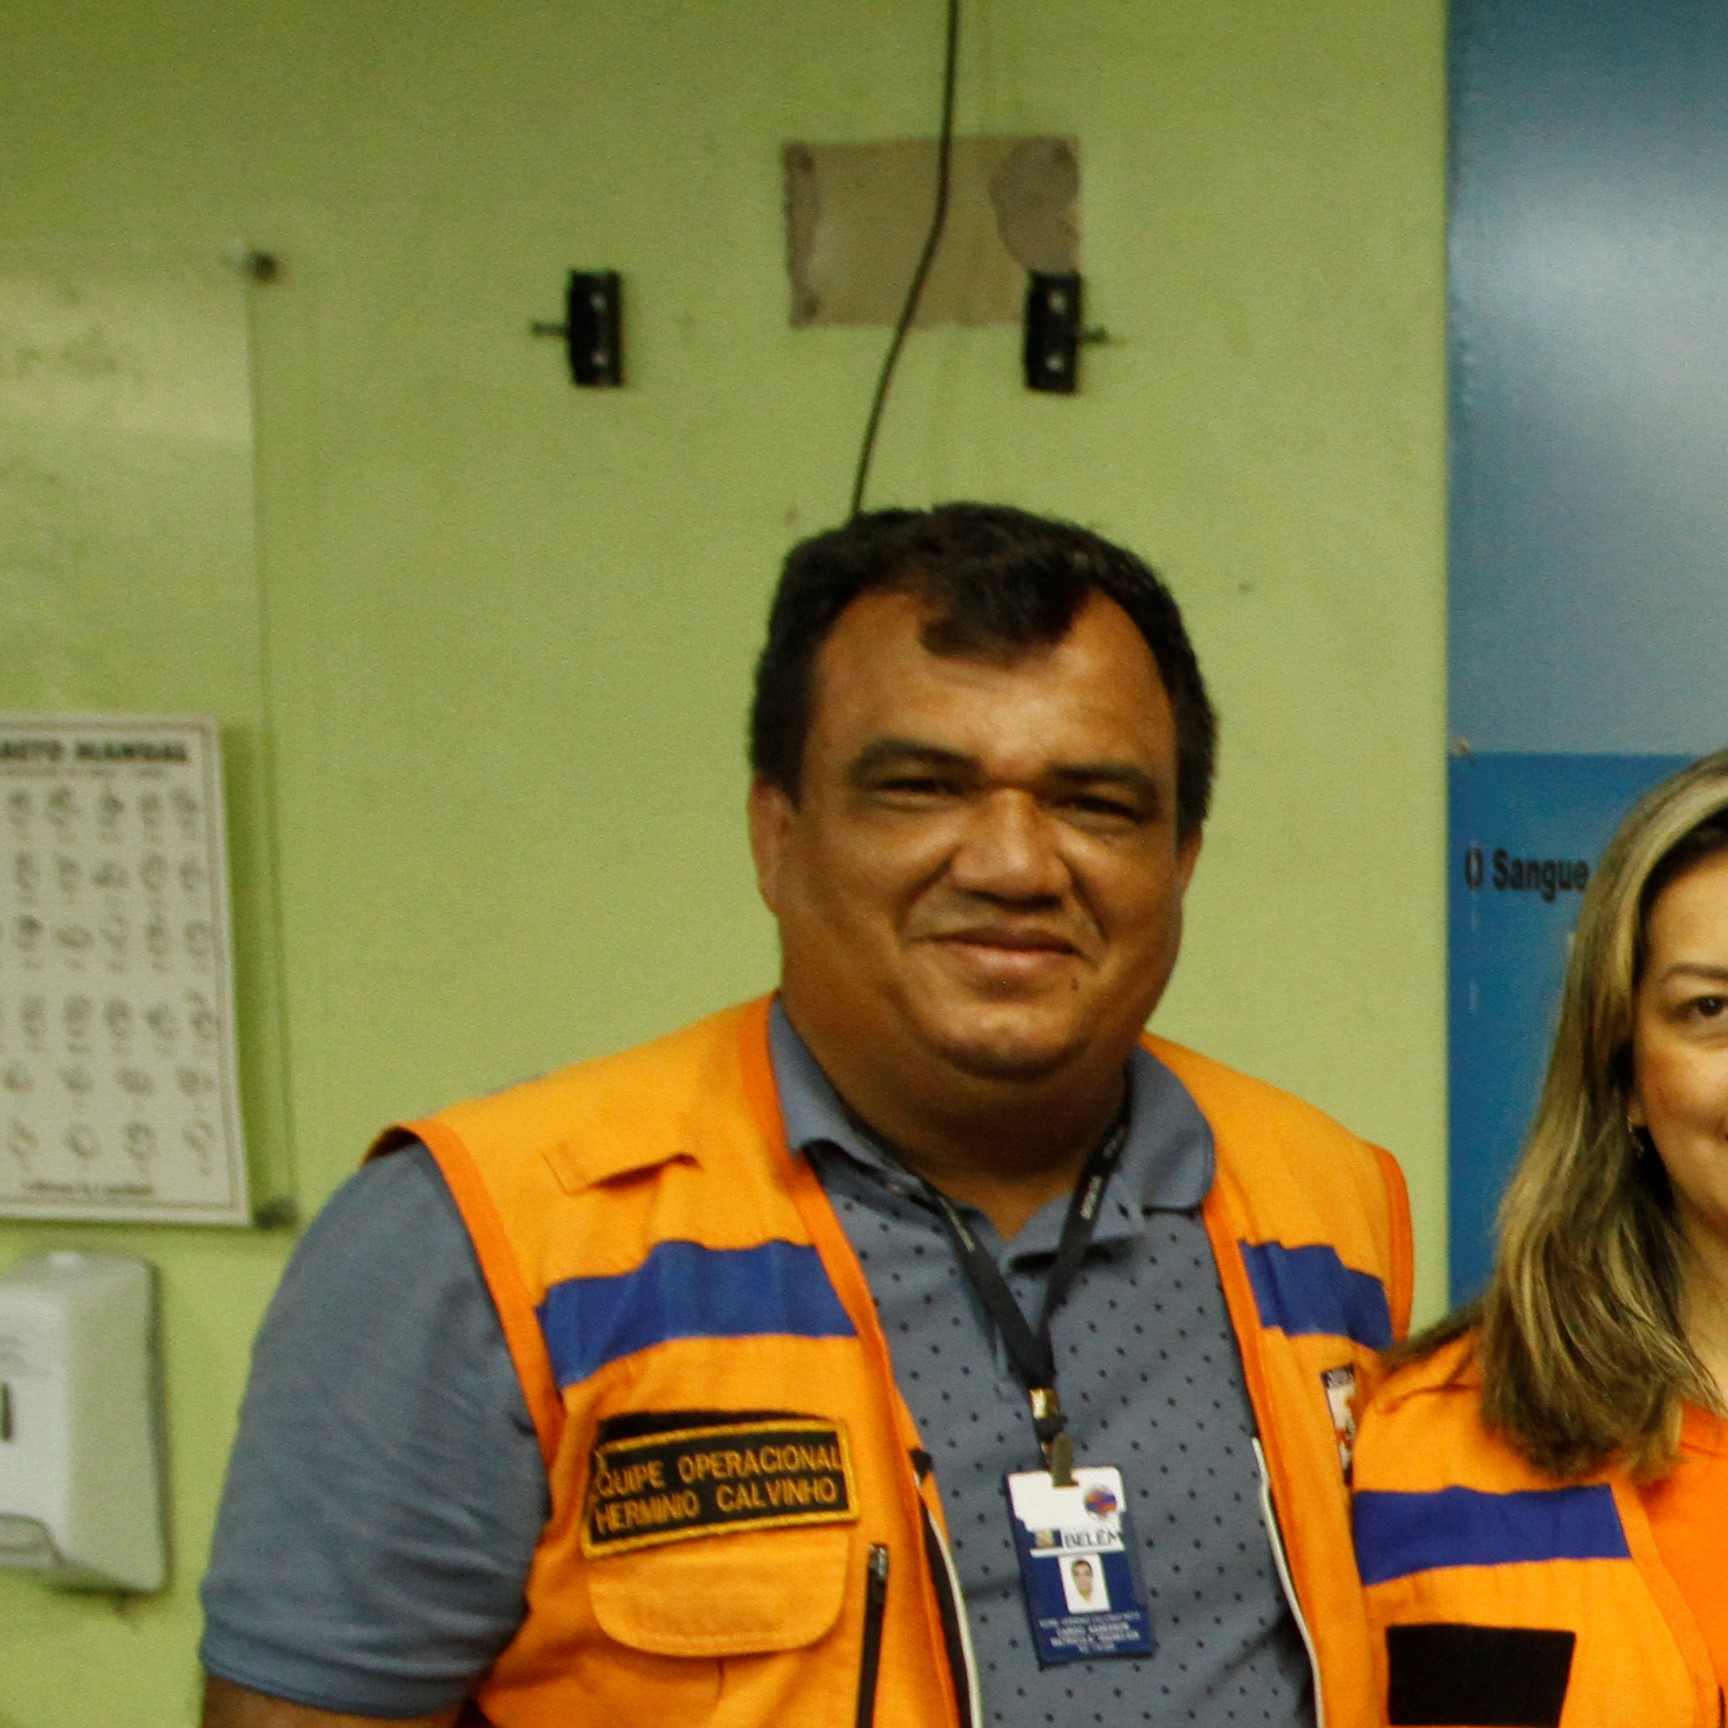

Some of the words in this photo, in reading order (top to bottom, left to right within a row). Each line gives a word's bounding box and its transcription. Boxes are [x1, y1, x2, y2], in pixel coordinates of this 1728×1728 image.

[1465, 847, 1484, 890] O
[1493, 848, 1590, 903] Sangue
[677, 1444, 844, 1485] OPERACIONAL
[716, 1476, 837, 1512] CALVINHO
